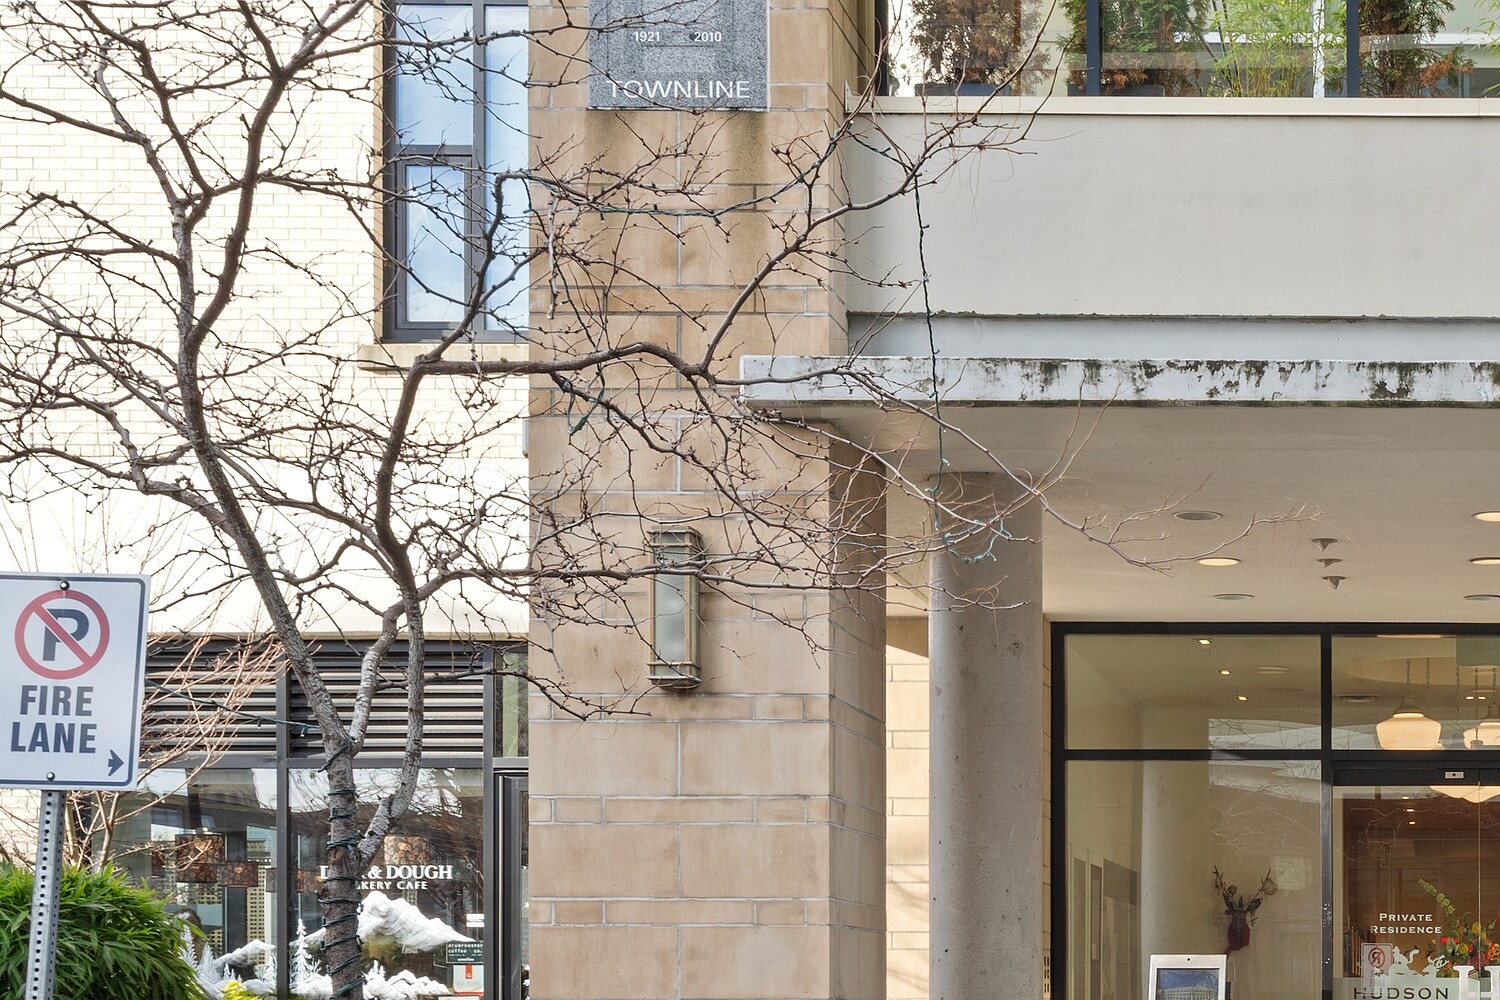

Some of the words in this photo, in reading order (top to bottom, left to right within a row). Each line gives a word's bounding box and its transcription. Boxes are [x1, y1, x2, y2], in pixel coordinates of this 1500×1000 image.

[633, 31, 661, 42] 1921
[693, 31, 723, 42] 2010
[605, 80, 751, 99] TOWNLINE
[42, 608, 90, 662] P
[20, 685, 94, 717] FIRE
[10, 721, 98, 754] LANE
[367, 865, 383, 879] &
[386, 865, 454, 880] DOUGH
[396, 880, 428, 890] CAFE
[1379, 912, 1433, 922] PRIVATE
[1370, 925, 1442, 935] RESIDENCE
[1353, 986, 1450, 1000] HUDSON
